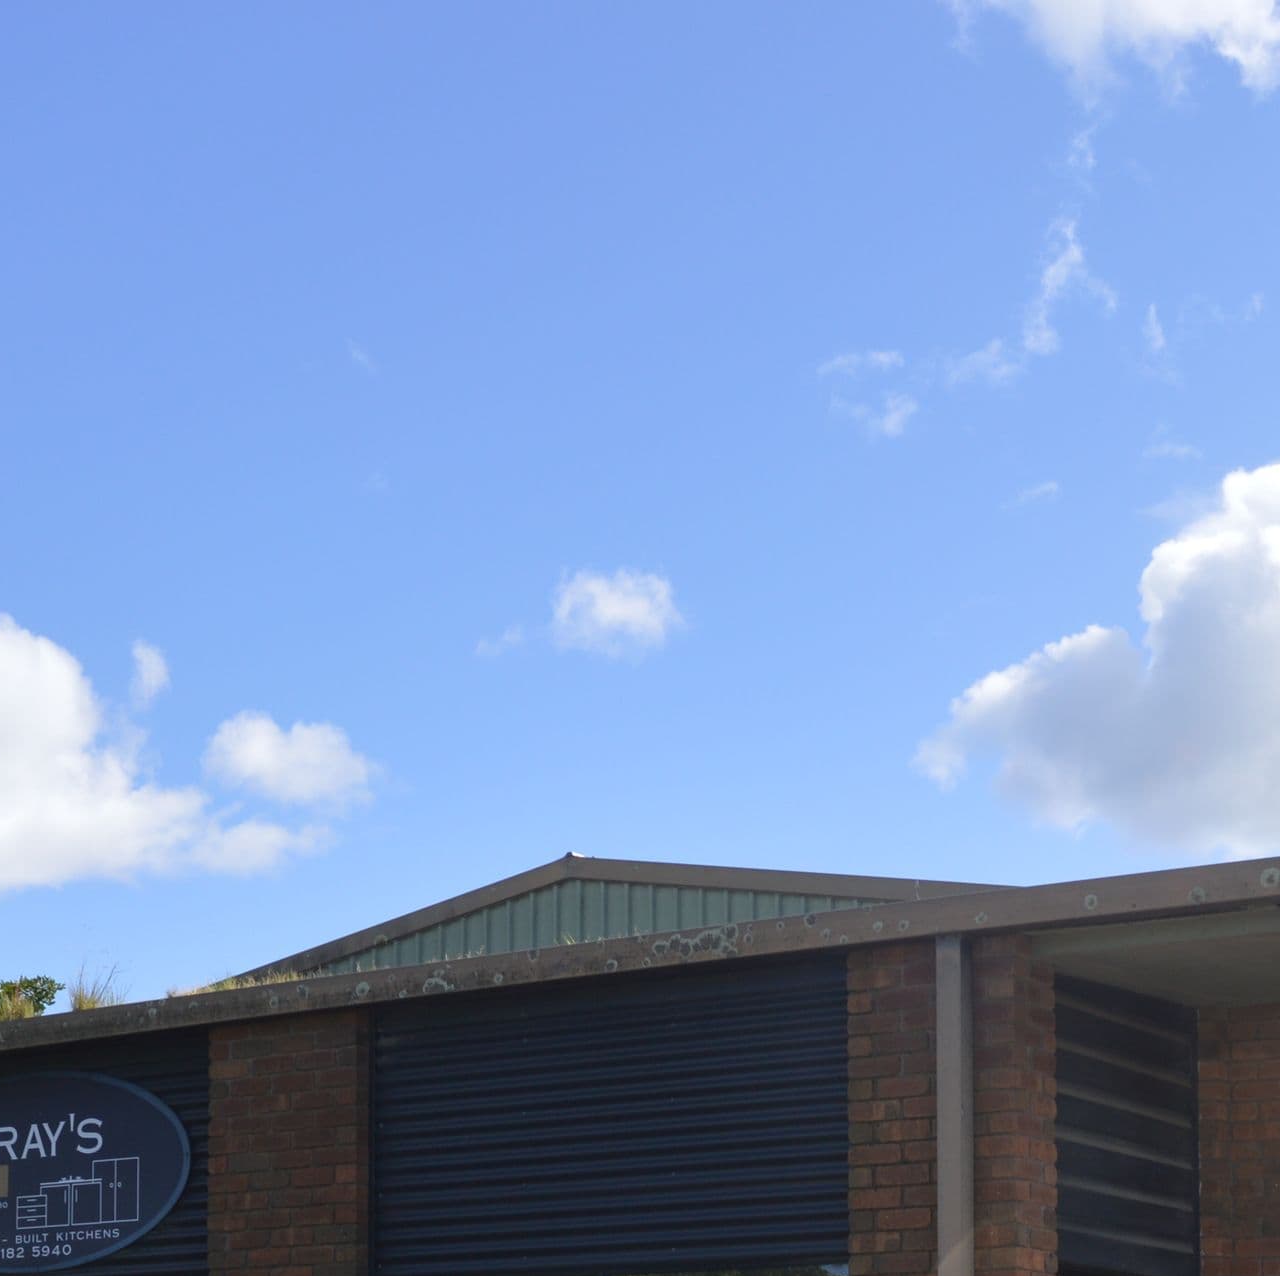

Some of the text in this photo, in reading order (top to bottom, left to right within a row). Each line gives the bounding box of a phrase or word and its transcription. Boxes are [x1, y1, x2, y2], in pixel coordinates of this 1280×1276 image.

[15, 1232, 49, 1245] BUILT
[56, 1228, 120, 1242] KITCHENS
[32, 1244, 72, 1257] 5940
